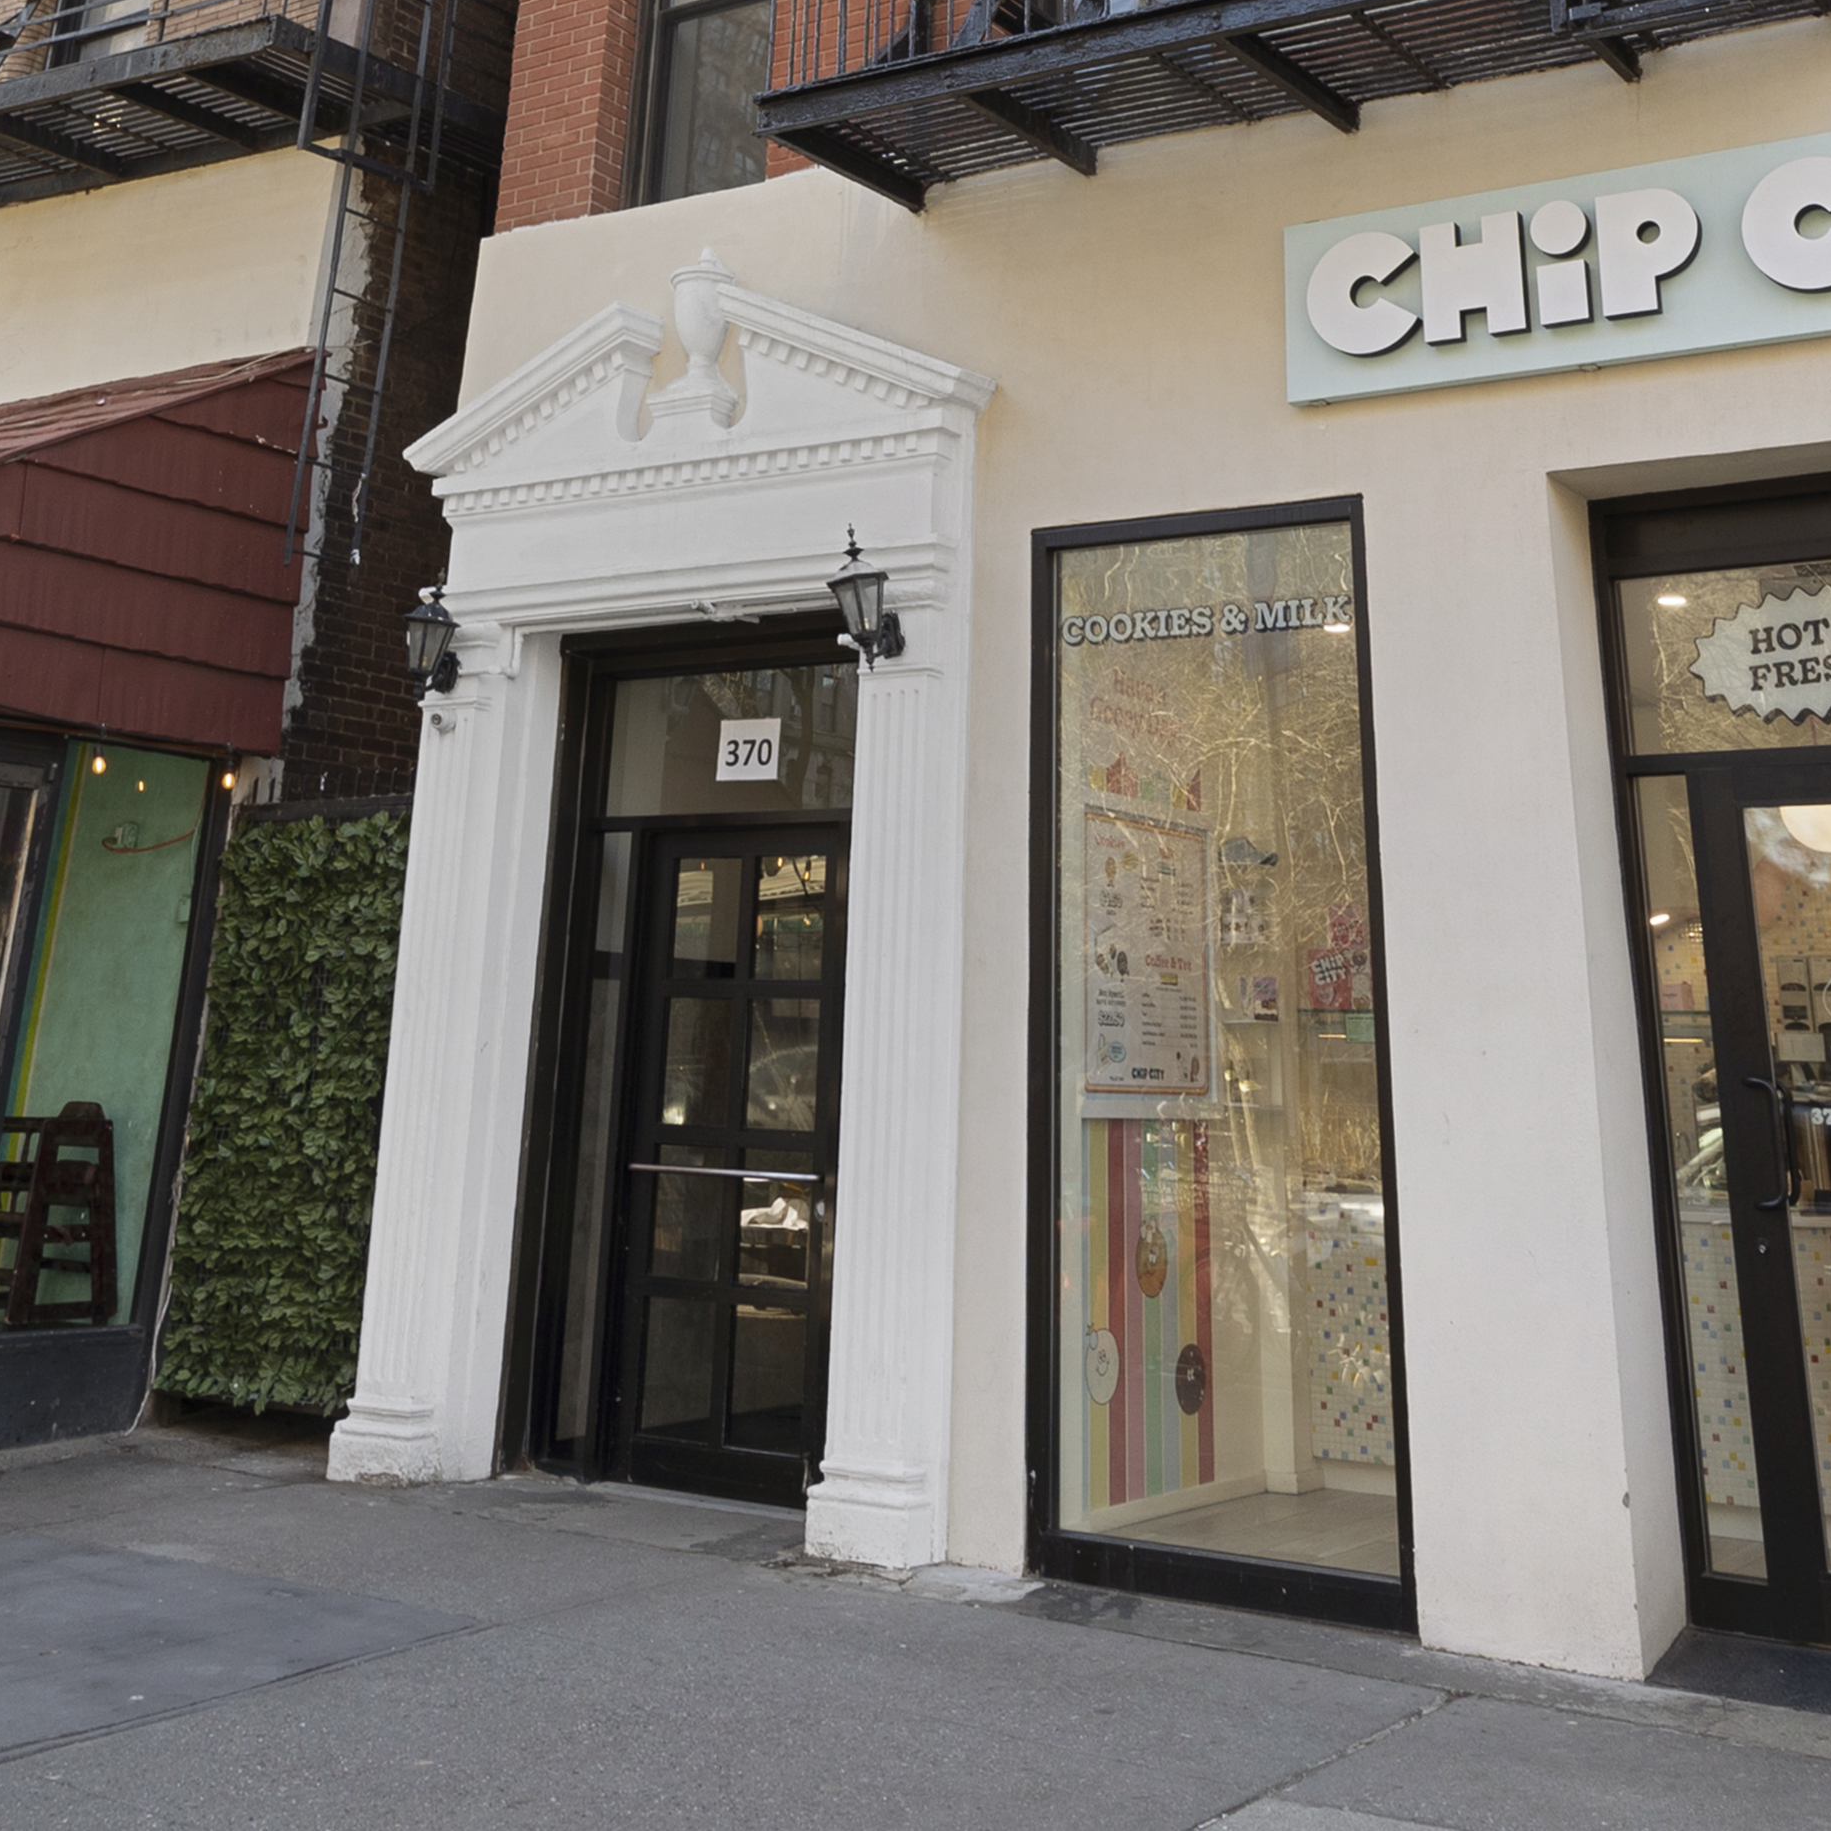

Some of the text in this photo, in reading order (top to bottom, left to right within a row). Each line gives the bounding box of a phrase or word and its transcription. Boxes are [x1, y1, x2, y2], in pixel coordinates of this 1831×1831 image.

[1062, 594, 1350, 646] COOKIES & MILK
[1749, 618, 1830, 654] HOT
[725, 738, 773, 767] 370
